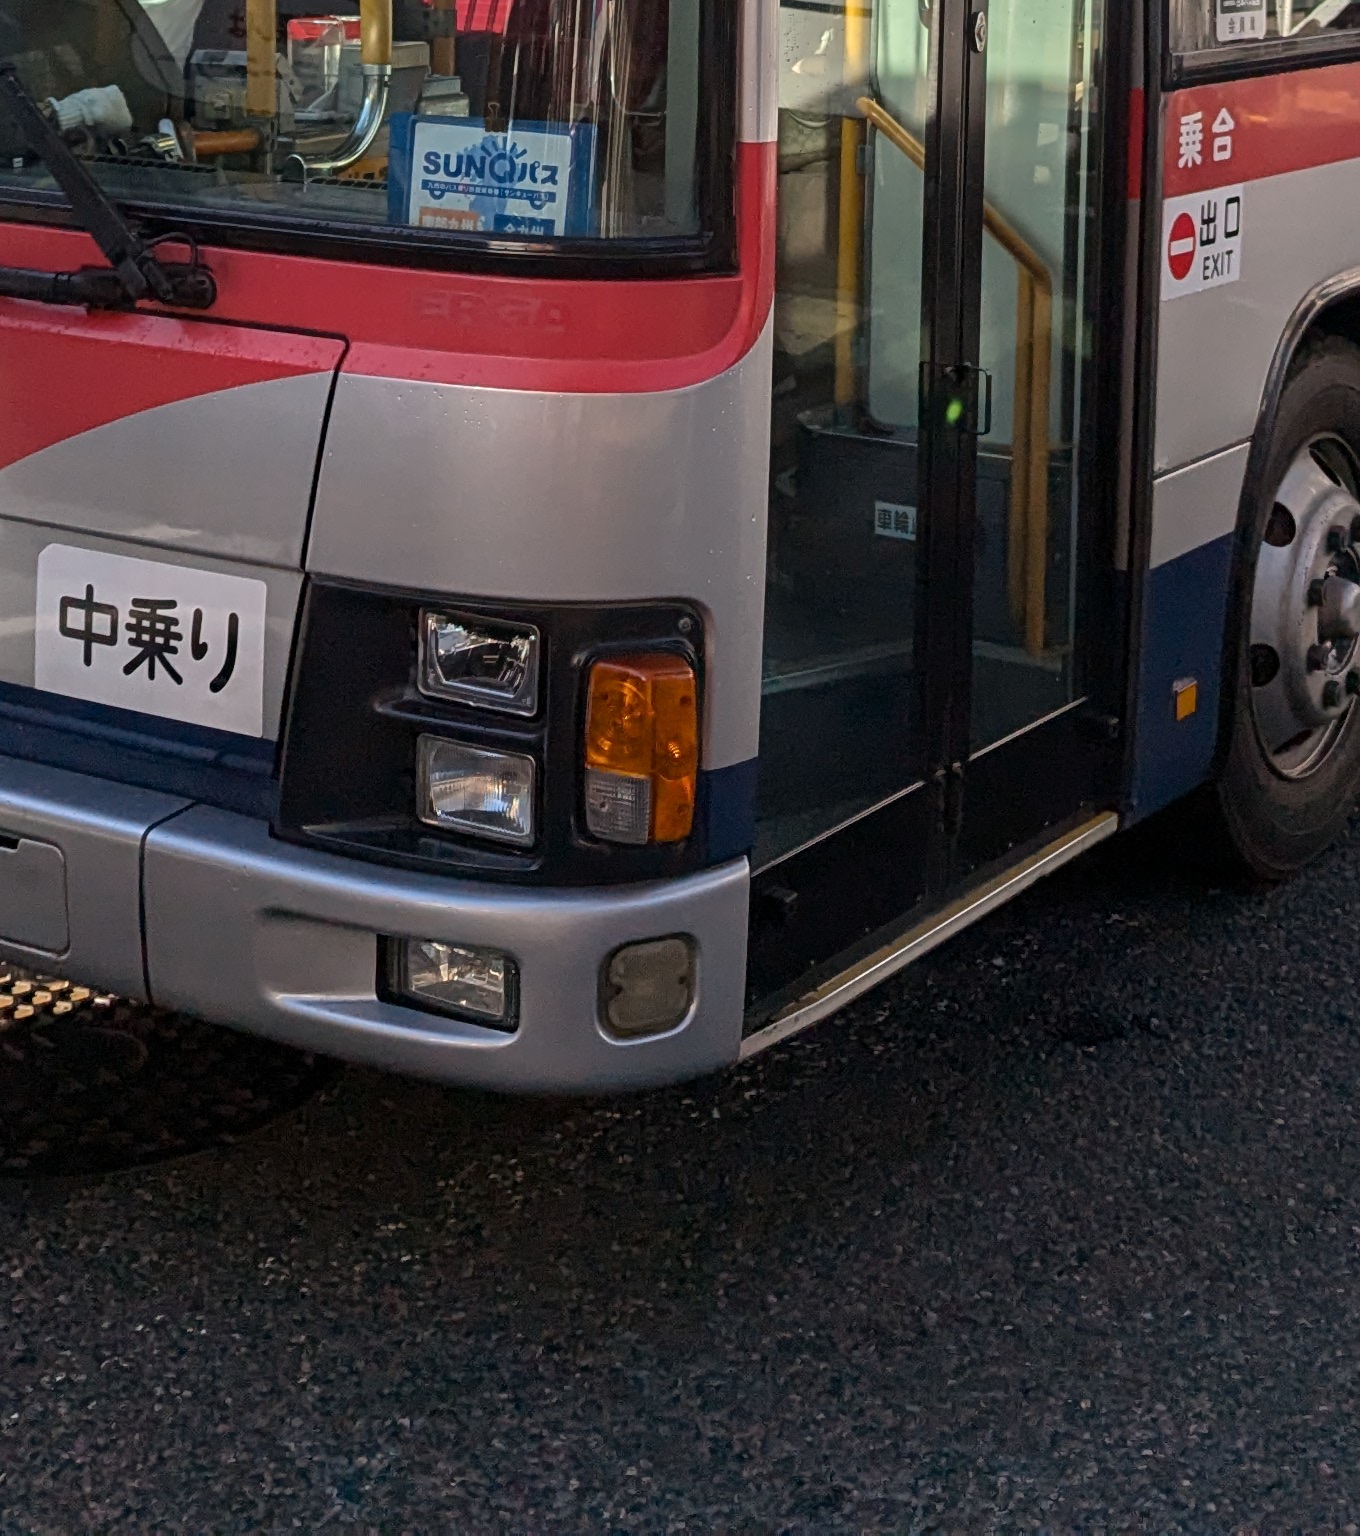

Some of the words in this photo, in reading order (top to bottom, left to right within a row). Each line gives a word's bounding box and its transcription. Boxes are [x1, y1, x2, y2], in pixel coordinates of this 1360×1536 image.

[1178, 107, 1236, 168] 乗合
[1200, 196, 1240, 247] 出口
[1202, 249, 1234, 280] EXIT
[59, 583, 239, 693] 中乗り
